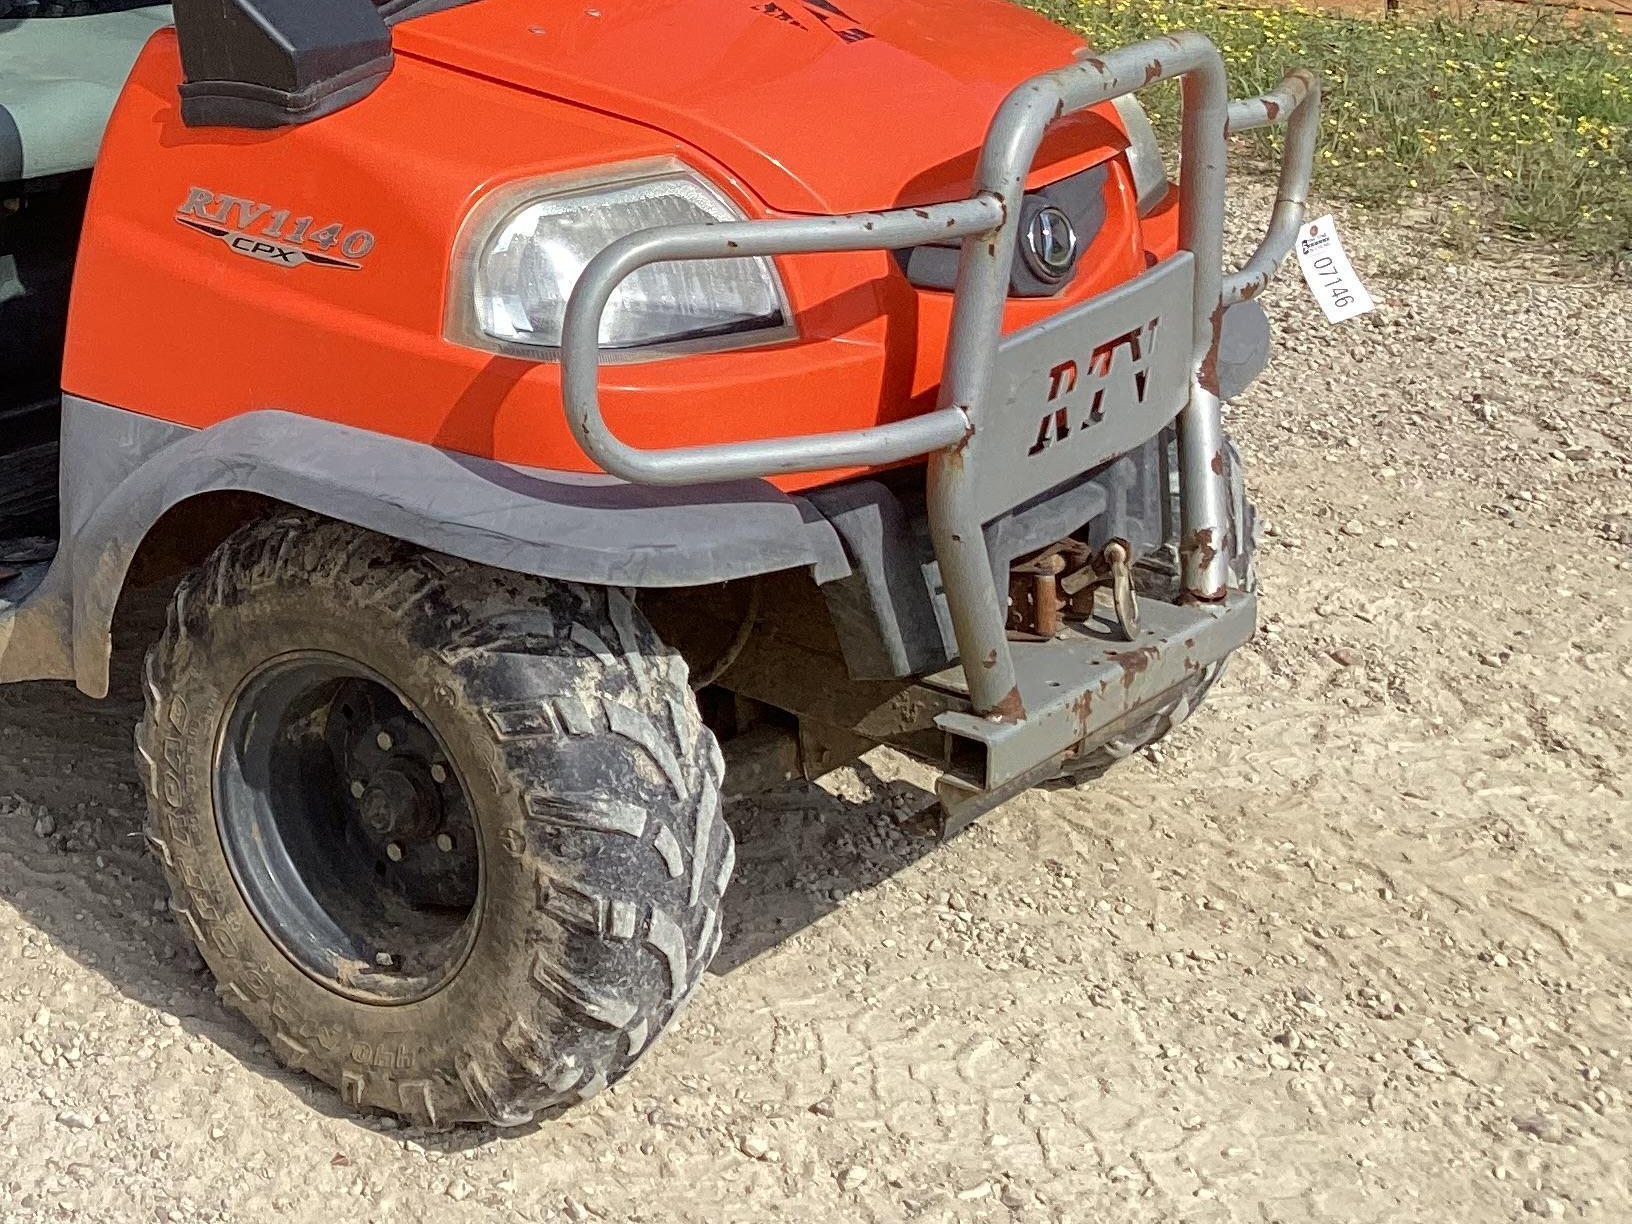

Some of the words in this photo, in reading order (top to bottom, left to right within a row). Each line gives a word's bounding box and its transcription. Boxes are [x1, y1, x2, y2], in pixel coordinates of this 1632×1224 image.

[177, 186, 375, 257] RTV1140
[232, 238, 294, 262] CPX
[1313, 256, 1355, 308] 07146
[1027, 316, 1160, 457] RTV
